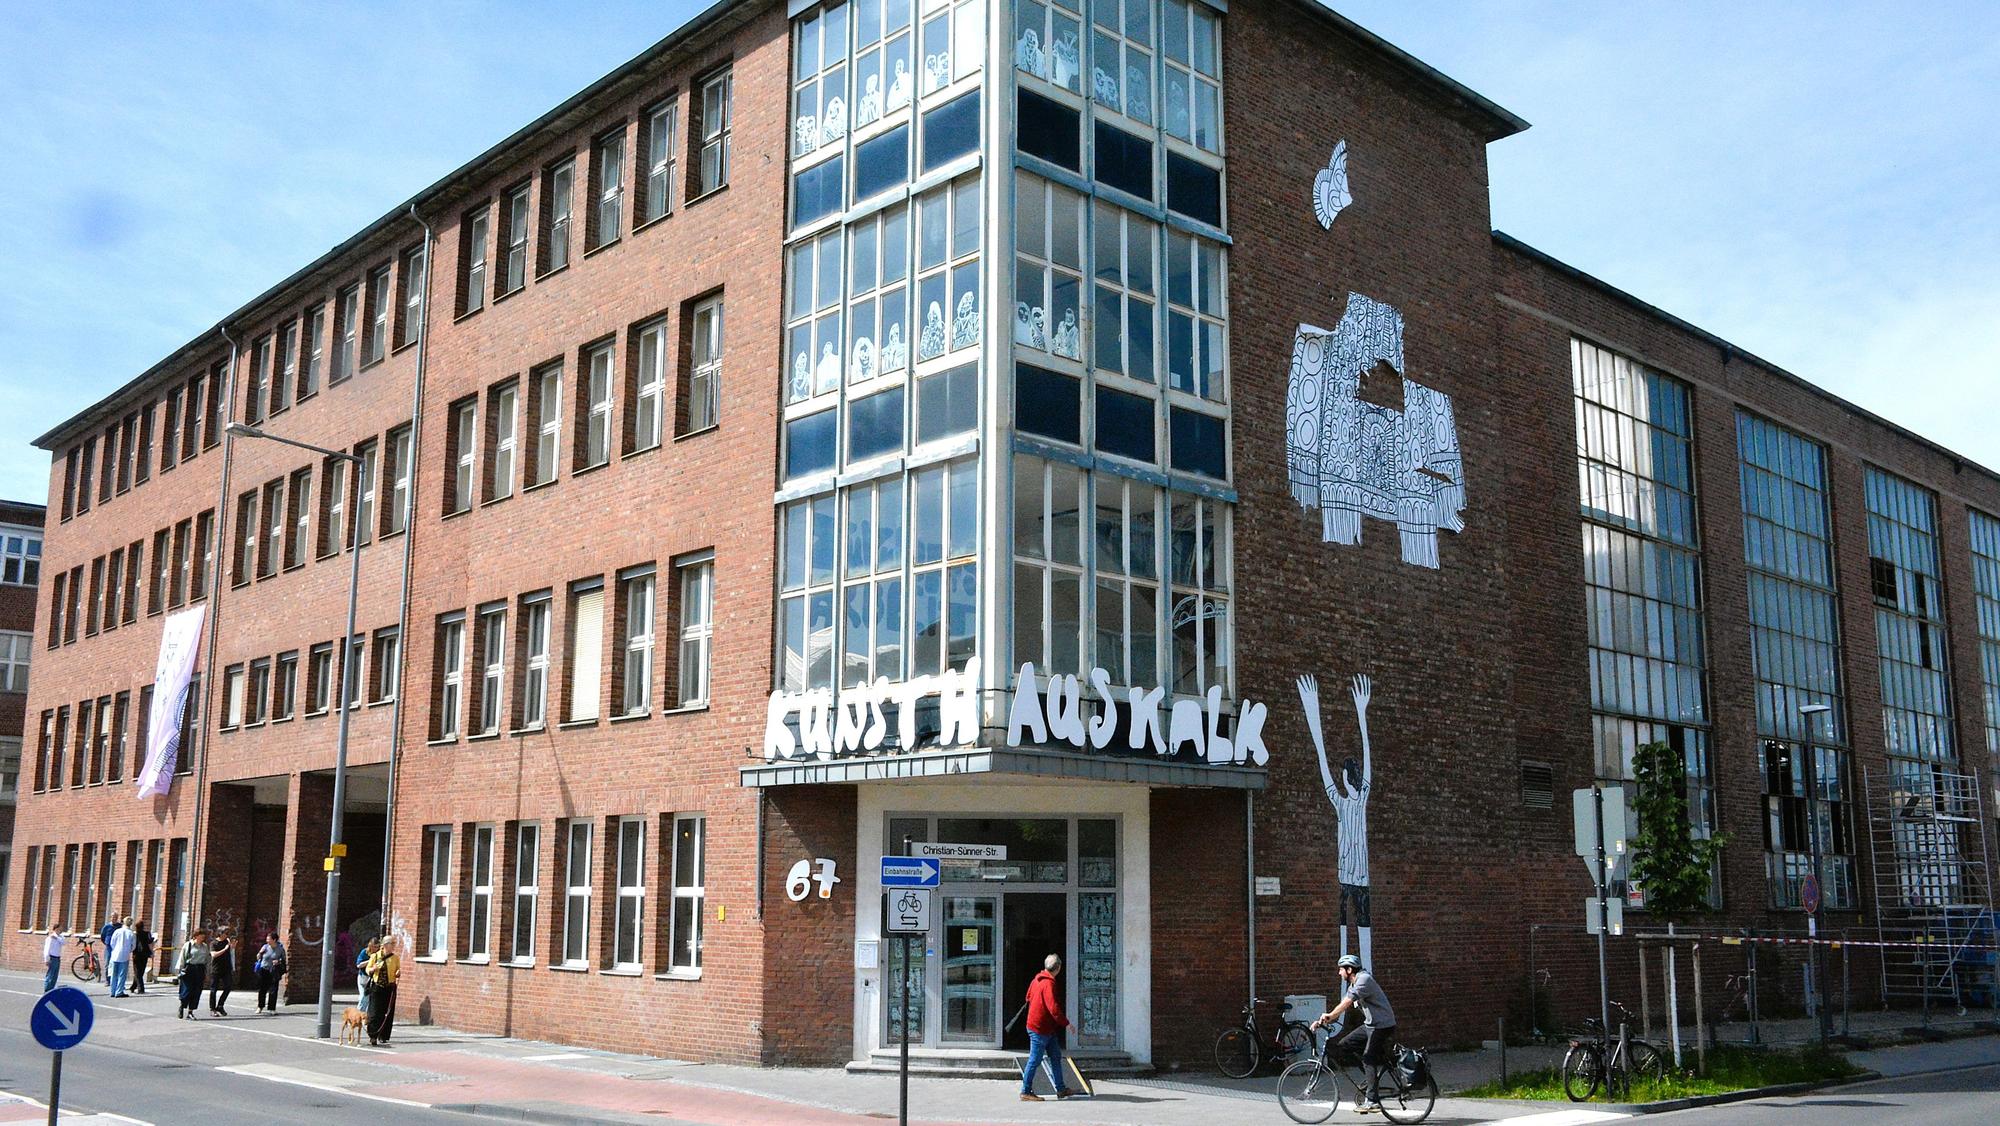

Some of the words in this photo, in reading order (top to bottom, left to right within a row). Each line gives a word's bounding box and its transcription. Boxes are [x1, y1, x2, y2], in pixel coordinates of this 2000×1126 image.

[922, 845, 999, 857] Christian-Sünner-Str.
[884, 867, 923, 876] Einbahnstraße
[785, 857, 842, 902] 67
